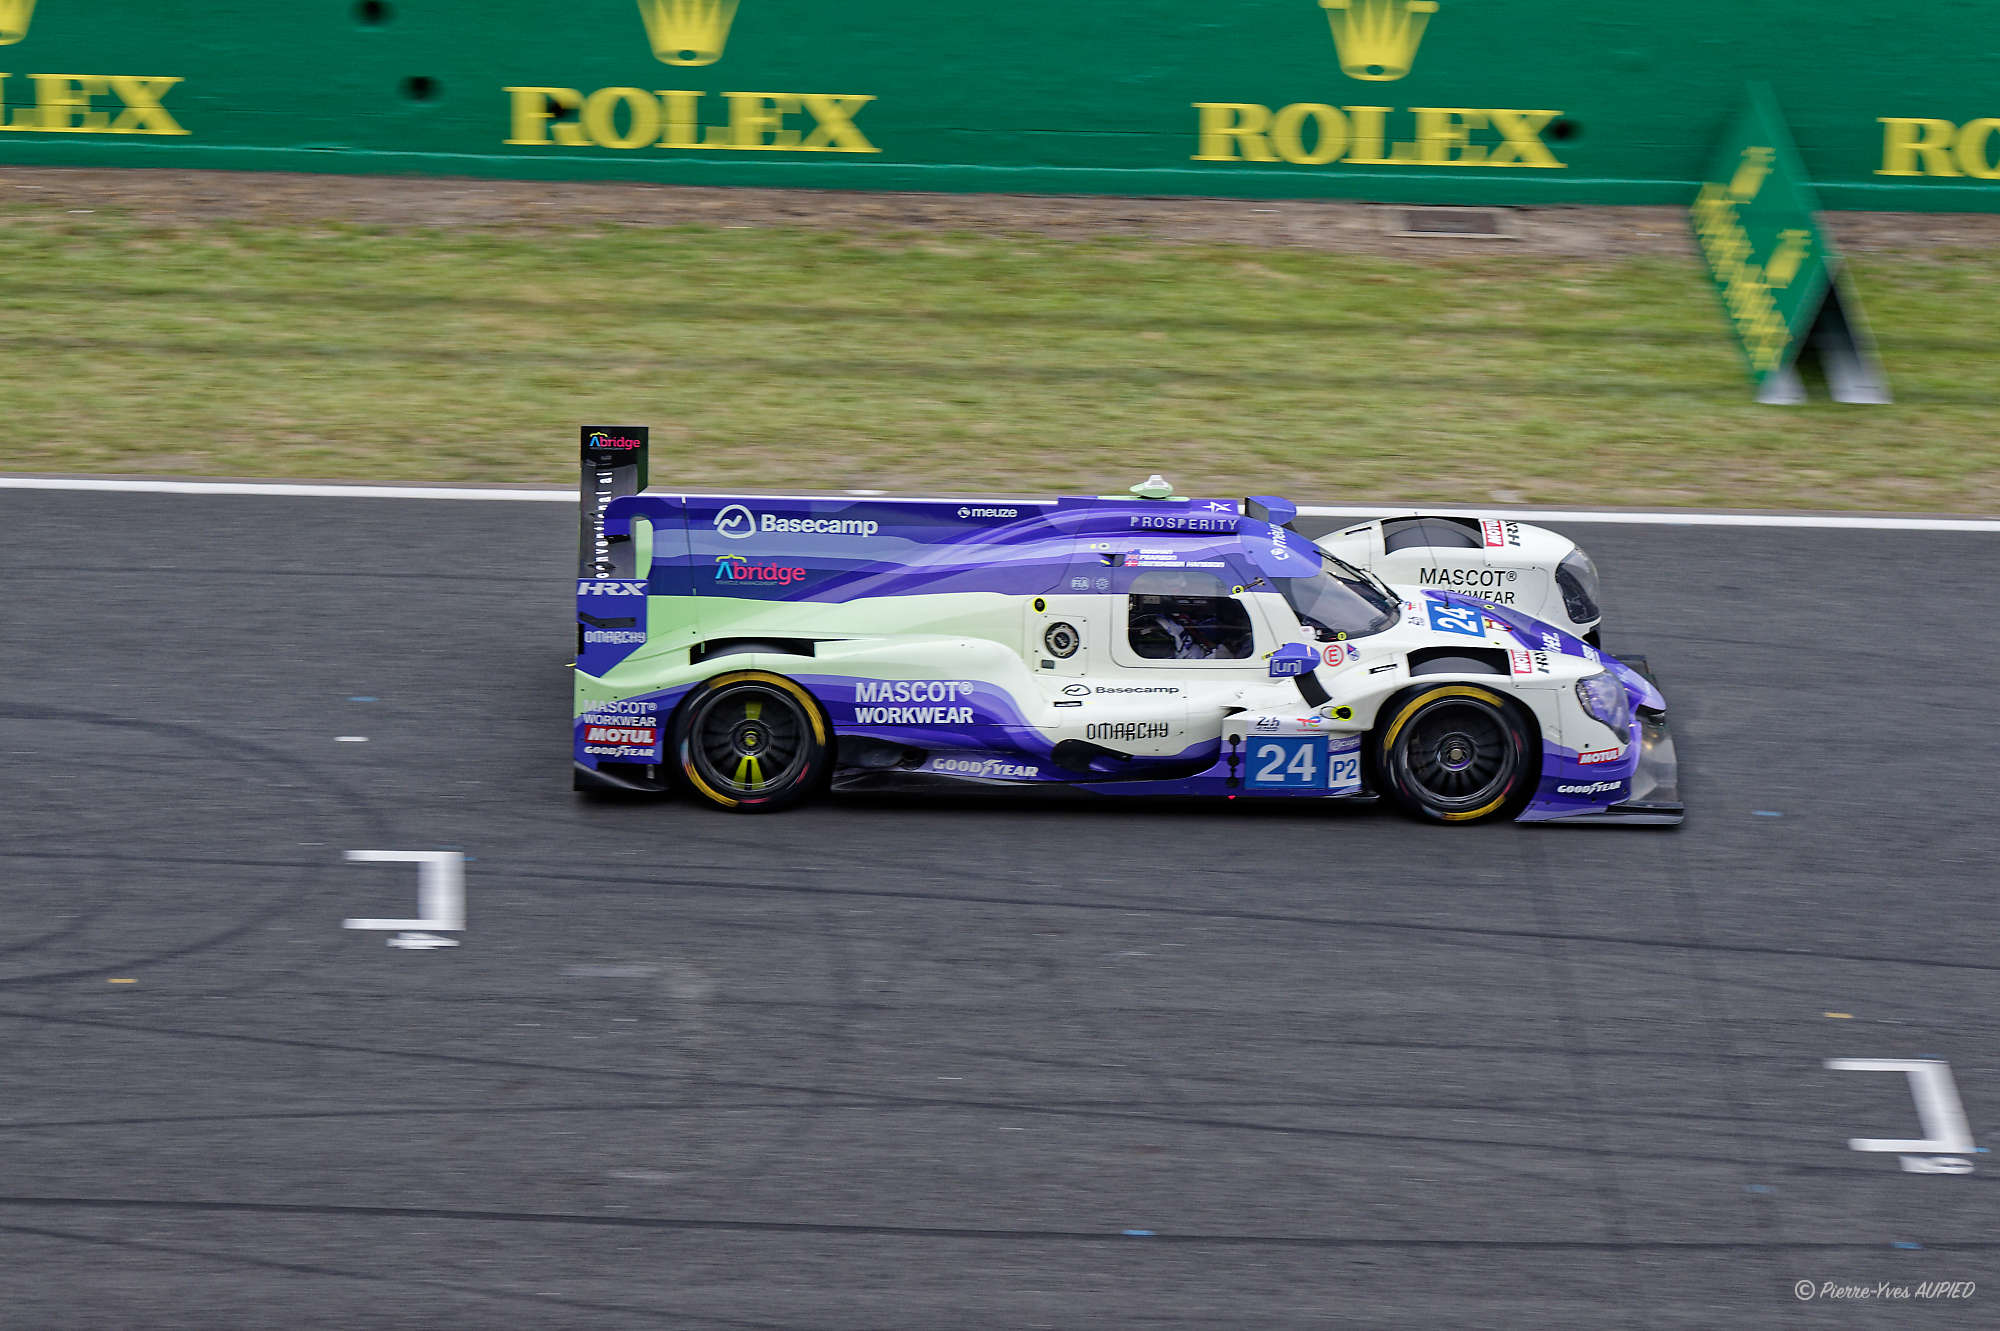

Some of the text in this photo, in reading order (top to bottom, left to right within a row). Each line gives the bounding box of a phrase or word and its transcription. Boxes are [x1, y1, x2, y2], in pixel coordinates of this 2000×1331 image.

[502, 86, 882, 153] ROLEX
[1191, 102, 1568, 169] ROLEX
[589, 435, 641, 451] Abridge
[971, 507, 1018, 518] meuze
[761, 514, 879, 537] Basecamp
[1130, 516, 1238, 530] PROSPERITY
[715, 561, 807, 585] Abridge
[576, 582, 649, 596] HRX
[1434, 606, 1479, 632] 24
[1096, 685, 1180, 695] Basecamp
[584, 714, 657, 727] WORKWEAR
[855, 707, 974, 724] WORKWEAR
[588, 728, 654, 743] MOTUL
[1087, 722, 1168, 740] OMARCHY
[584, 746, 655, 757] GOODYEAR
[933, 758, 1039, 777] GOODYEAR
[1256, 743, 1317, 781] 24
[1333, 759, 1357, 781] P2
[1557, 781, 1622, 795] GOODYEAR
